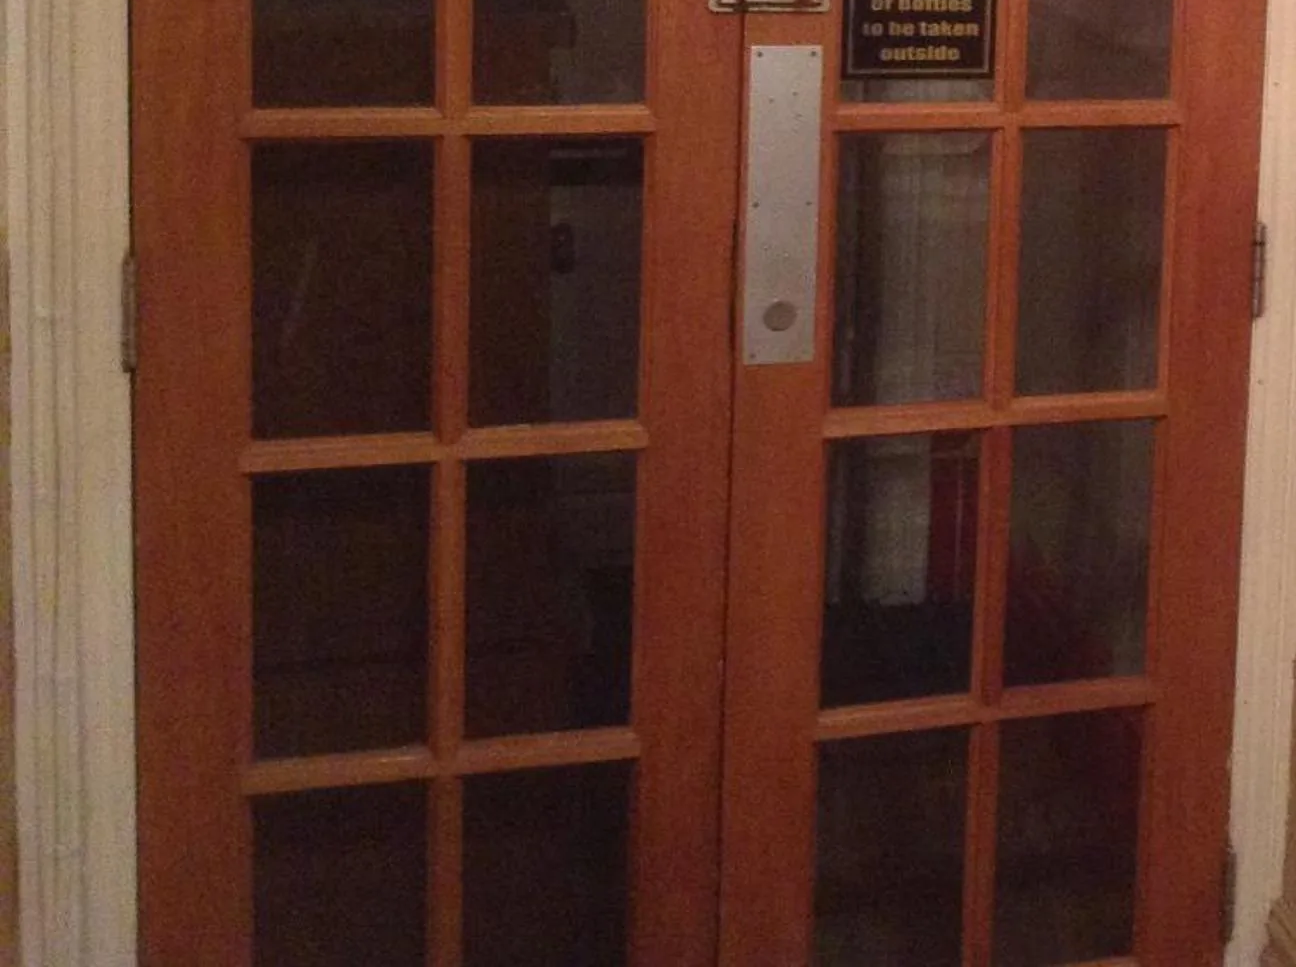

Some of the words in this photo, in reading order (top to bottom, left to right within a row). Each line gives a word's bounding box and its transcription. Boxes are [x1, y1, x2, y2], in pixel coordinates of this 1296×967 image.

[862, 21, 884, 37] to
[888, 21, 915, 36] be
[919, 19, 980, 37] taken
[880, 45, 961, 61] outside
